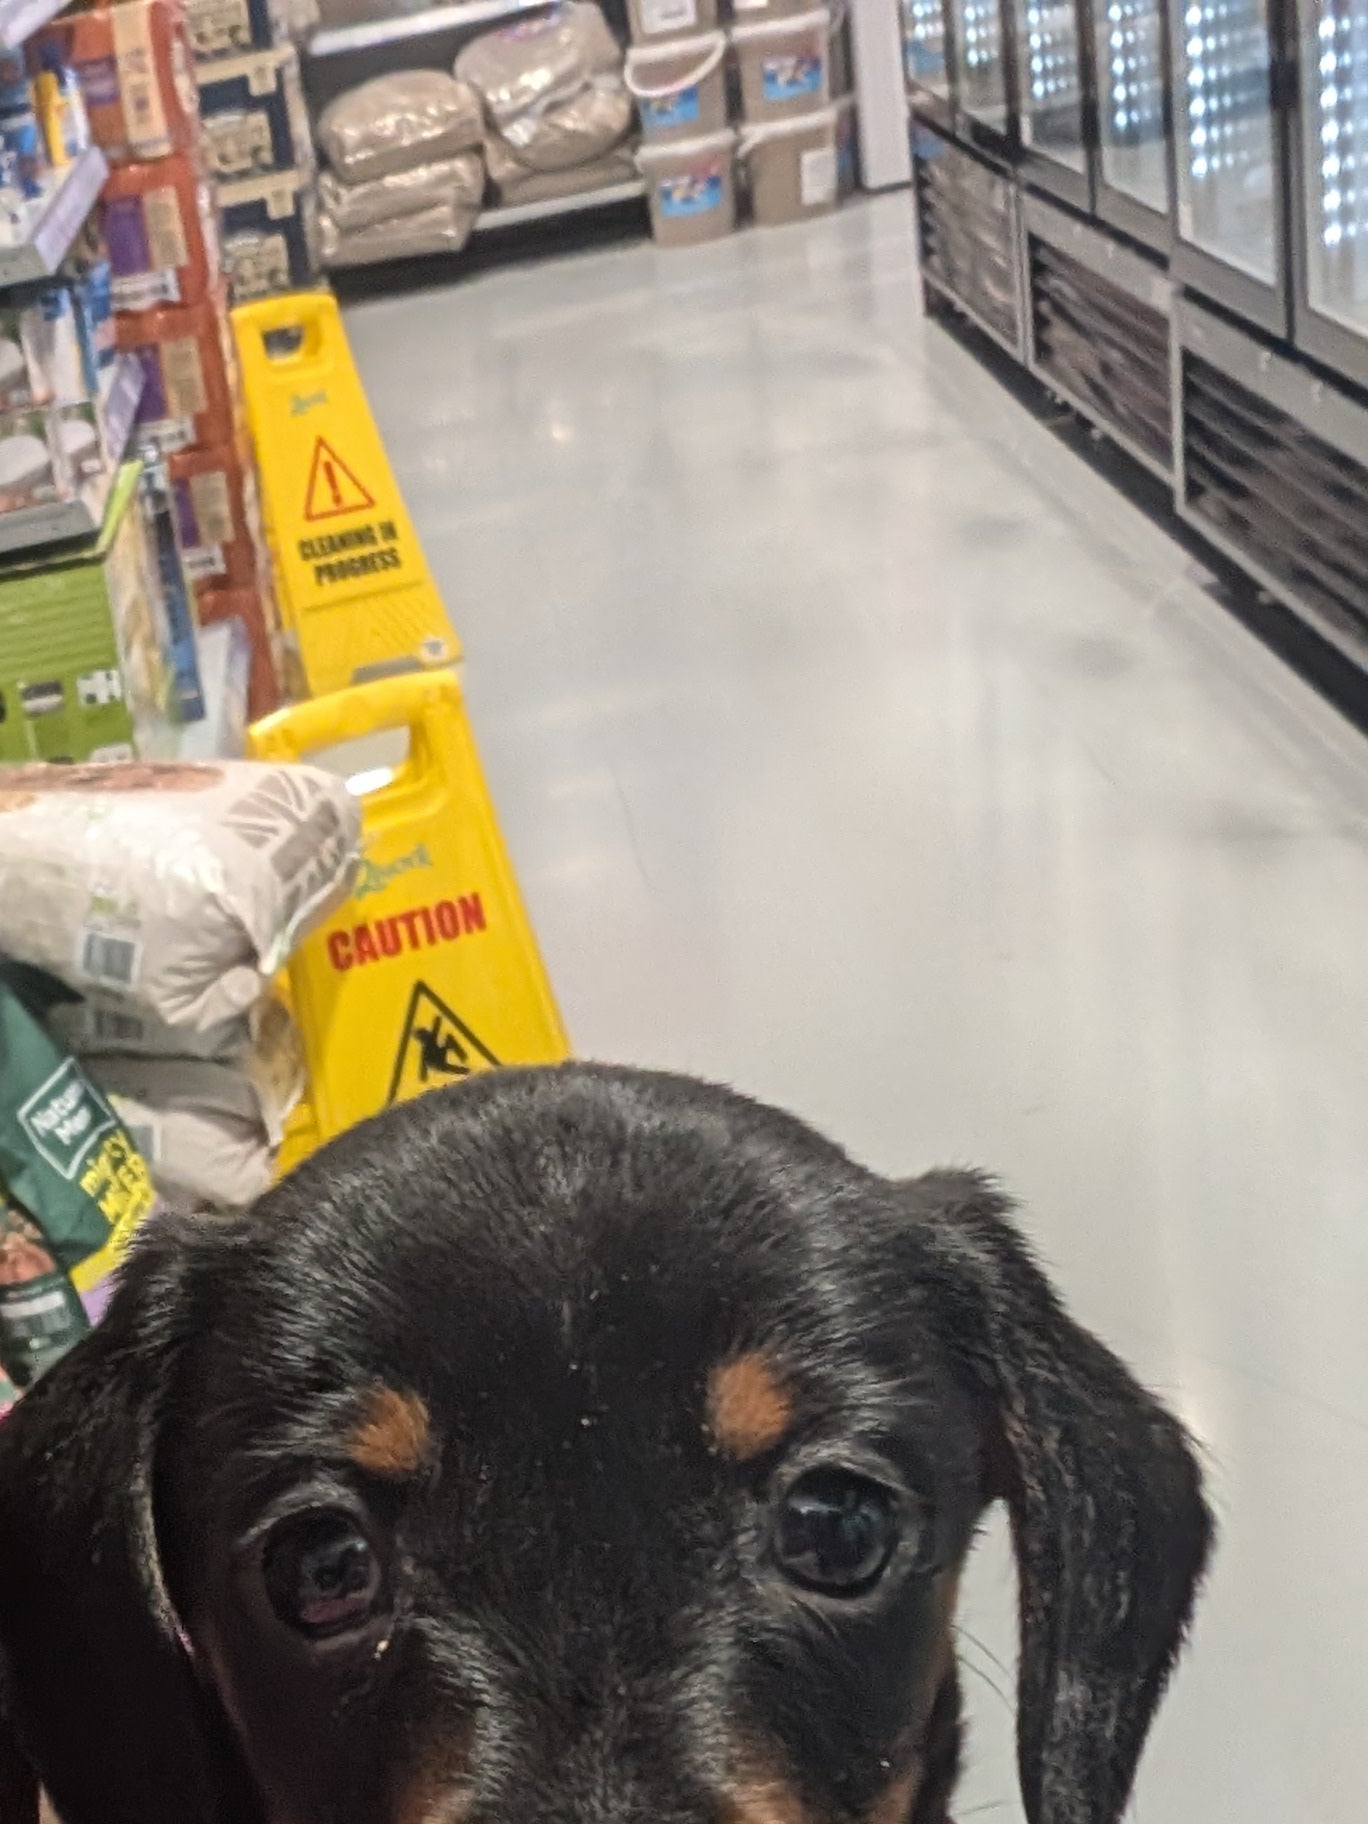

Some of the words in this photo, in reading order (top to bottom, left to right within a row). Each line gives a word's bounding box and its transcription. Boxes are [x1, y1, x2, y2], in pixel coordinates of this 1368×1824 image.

[298, 524, 378, 562] CLEANING
[378, 520, 398, 541] IN
[314, 546, 402, 586] PROGRESS
[327, 891, 487, 972] CAUTION
